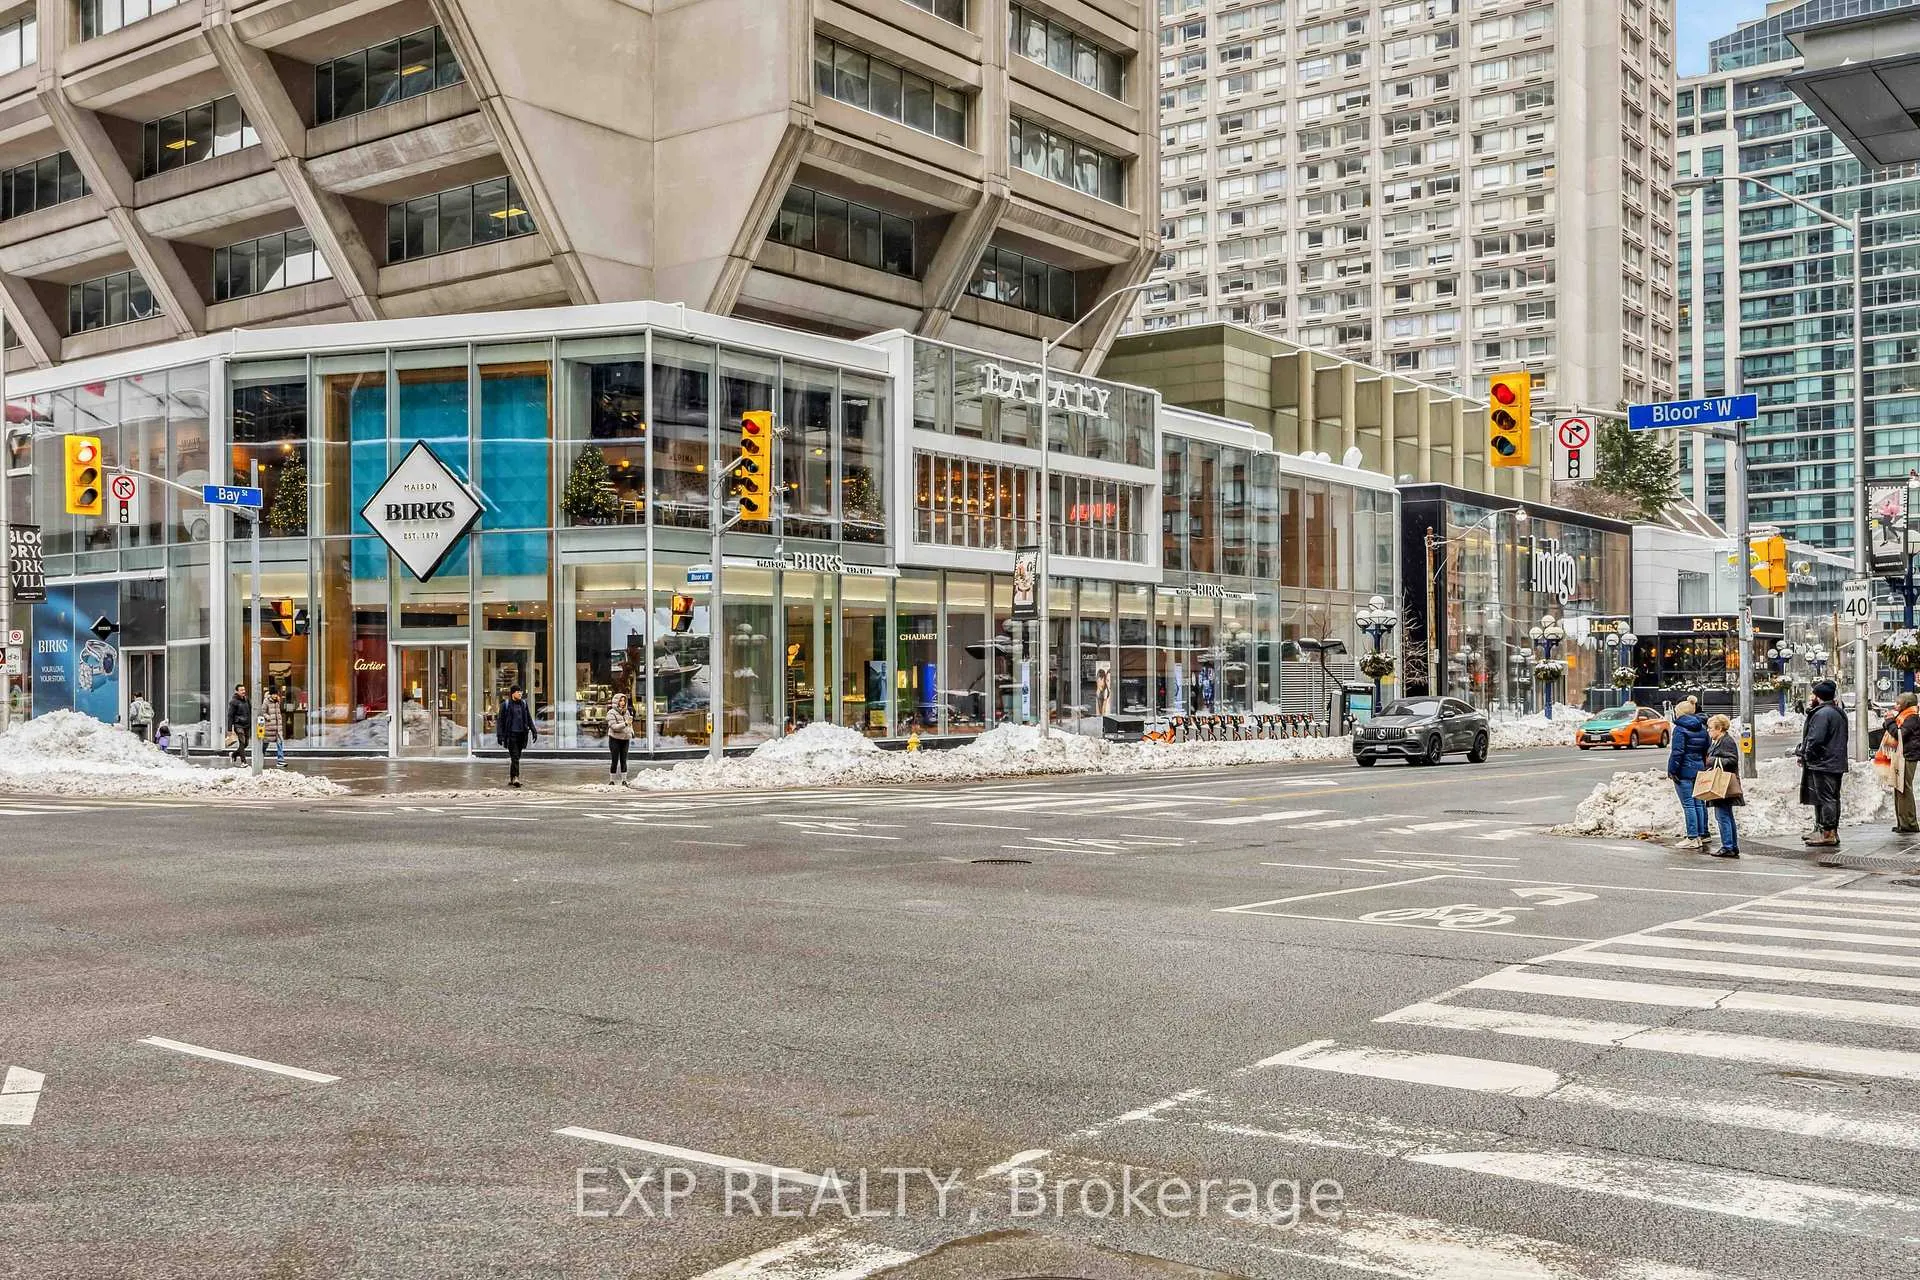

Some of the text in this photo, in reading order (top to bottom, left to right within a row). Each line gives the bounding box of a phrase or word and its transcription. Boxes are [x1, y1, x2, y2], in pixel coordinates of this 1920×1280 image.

[981, 363, 1111, 419] EATALY
[1652, 399, 1732, 422] Bloor St W
[404, 483, 438, 491] MAISON
[218, 487, 248, 503] Bay St
[385, 501, 455, 521] BIRKS
[404, 532, 439, 540] EST. 1879
[792, 551, 843, 572] BIRKS
[1196, 583, 1225, 598] BIRKS
[1844, 584, 1867, 592] MAXIMUM
[1845, 597, 1868, 617] 40
[1692, 617, 1729, 632] Earls
[899, 633, 937, 641] CHAUMET
[38, 639, 68, 653] BIRKS
[354, 658, 386, 670] Cartier
